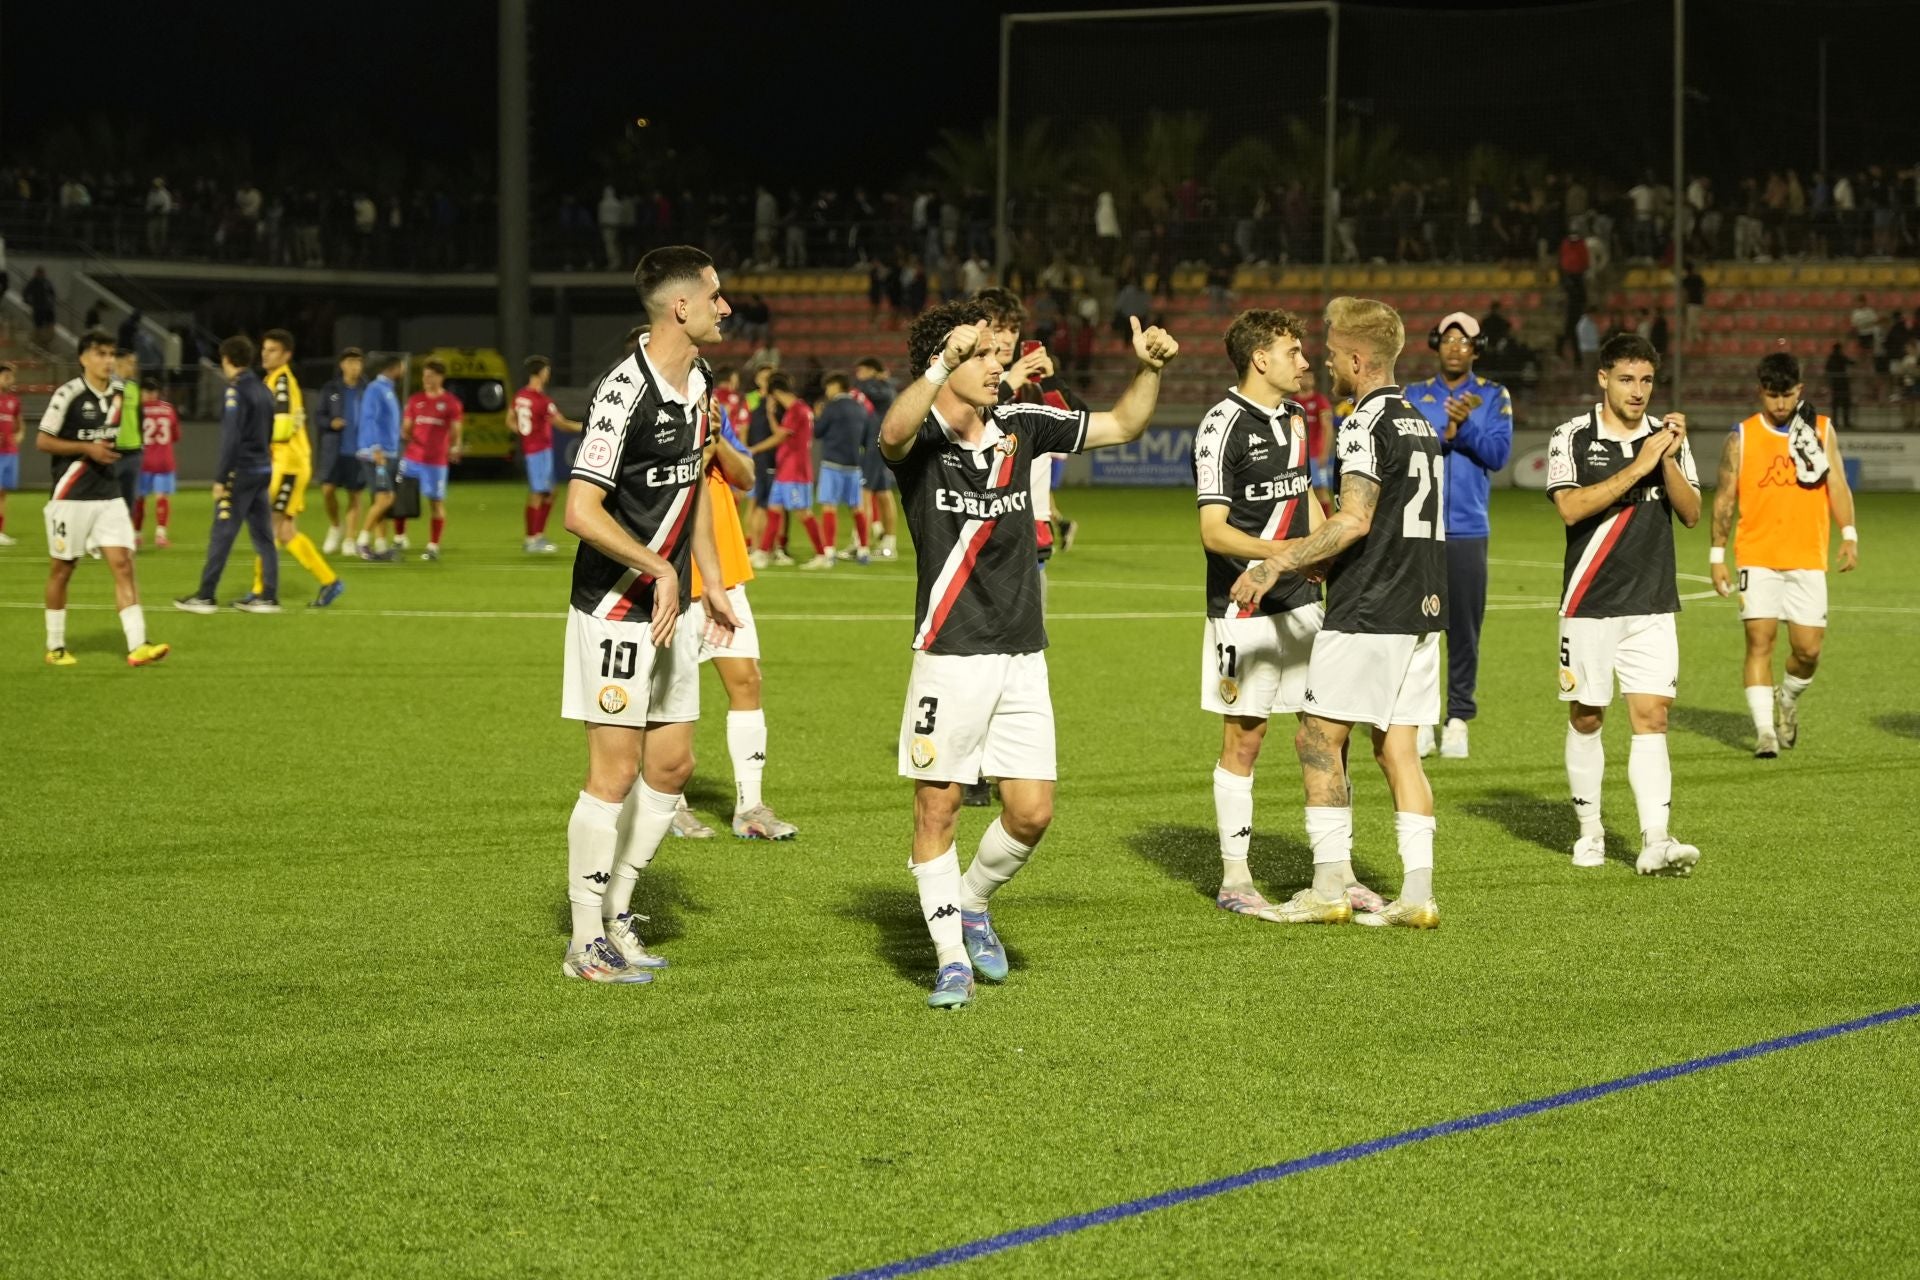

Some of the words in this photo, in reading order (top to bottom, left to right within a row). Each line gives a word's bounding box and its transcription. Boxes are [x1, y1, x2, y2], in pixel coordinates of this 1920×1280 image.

[143, 417, 171, 445] 23
[518, 407, 533, 436] 6
[1403, 451, 1445, 541] 21
[52, 519, 67, 538] 14
[600, 639, 637, 679] 10
[1217, 643, 1236, 677] 11
[1560, 636, 1570, 667] 5
[915, 696, 938, 735] 3
